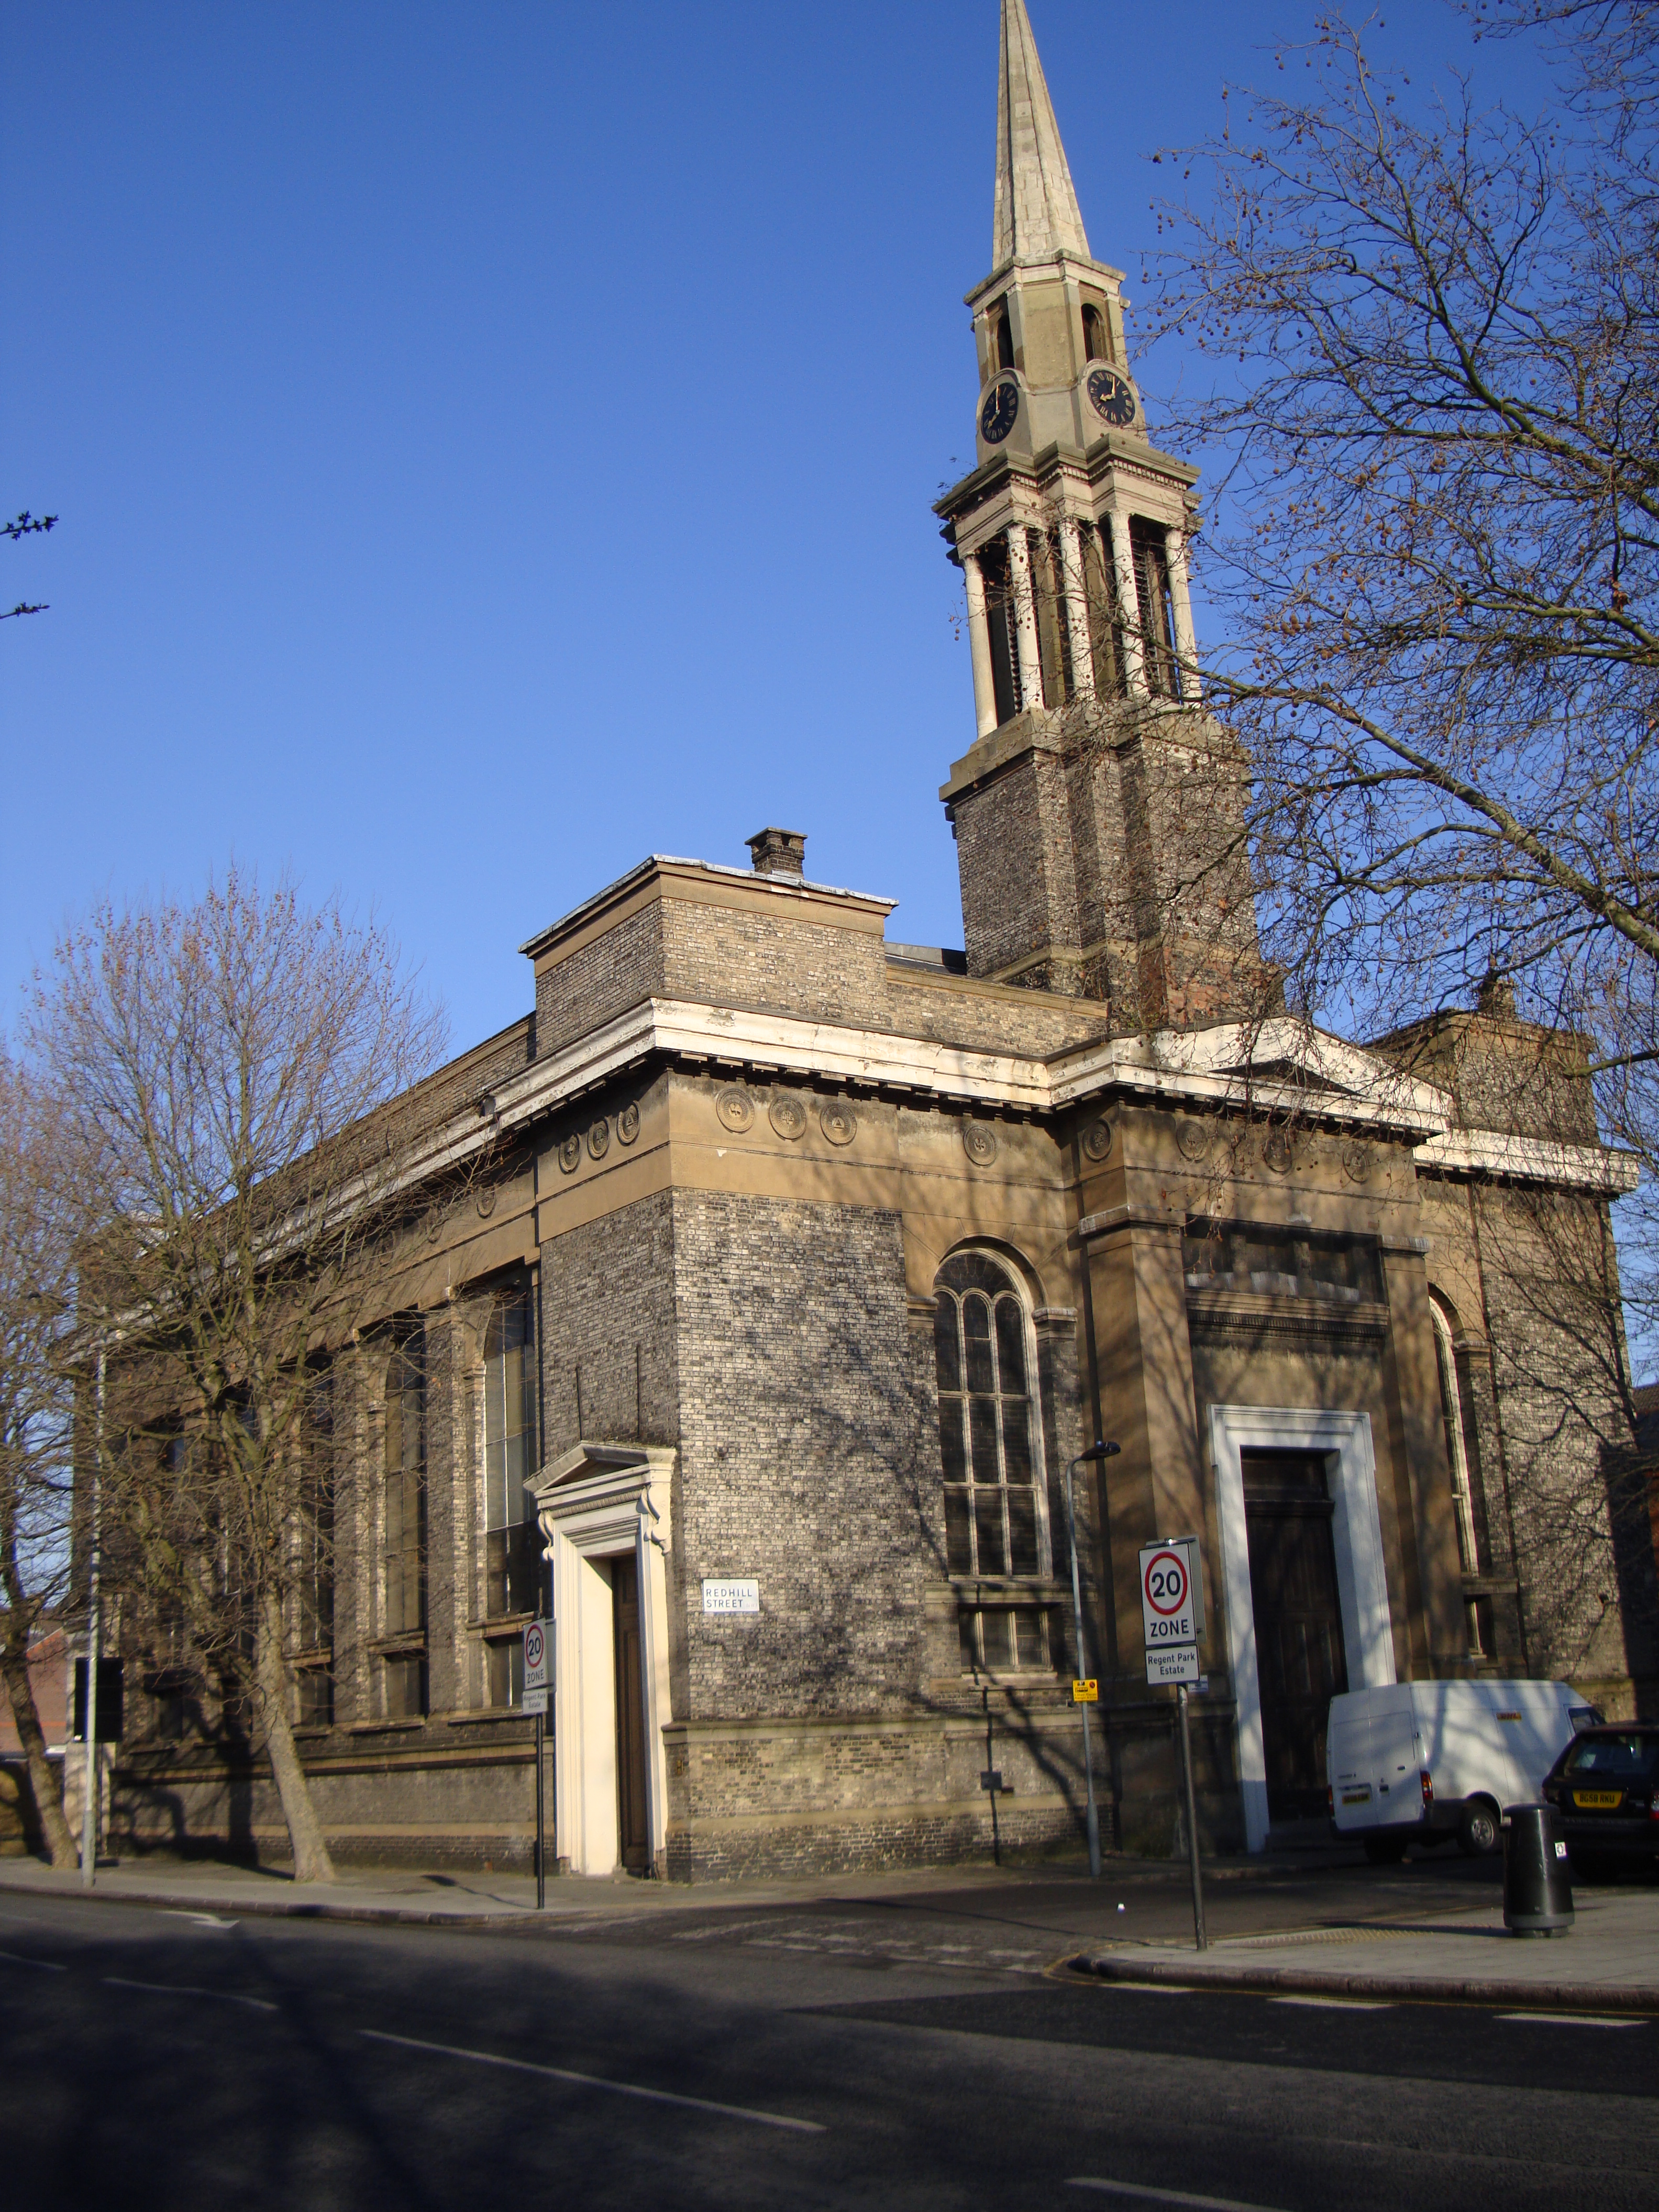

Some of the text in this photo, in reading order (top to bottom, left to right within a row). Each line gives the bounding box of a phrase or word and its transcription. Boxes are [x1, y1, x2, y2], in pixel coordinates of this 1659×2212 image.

[1152, 1570, 1180, 1597] 20
[706, 1588, 753, 1597] REDHILL
[706, 1599, 743, 1608] STREET
[1150, 1619, 1189, 1637] ZONE
[528, 1636, 540, 1656] 20
[1148, 1652, 1195, 1665] Regent Park
[527, 1669, 544, 1684] ZONE
[1160, 1665, 1185, 1675] Estate
